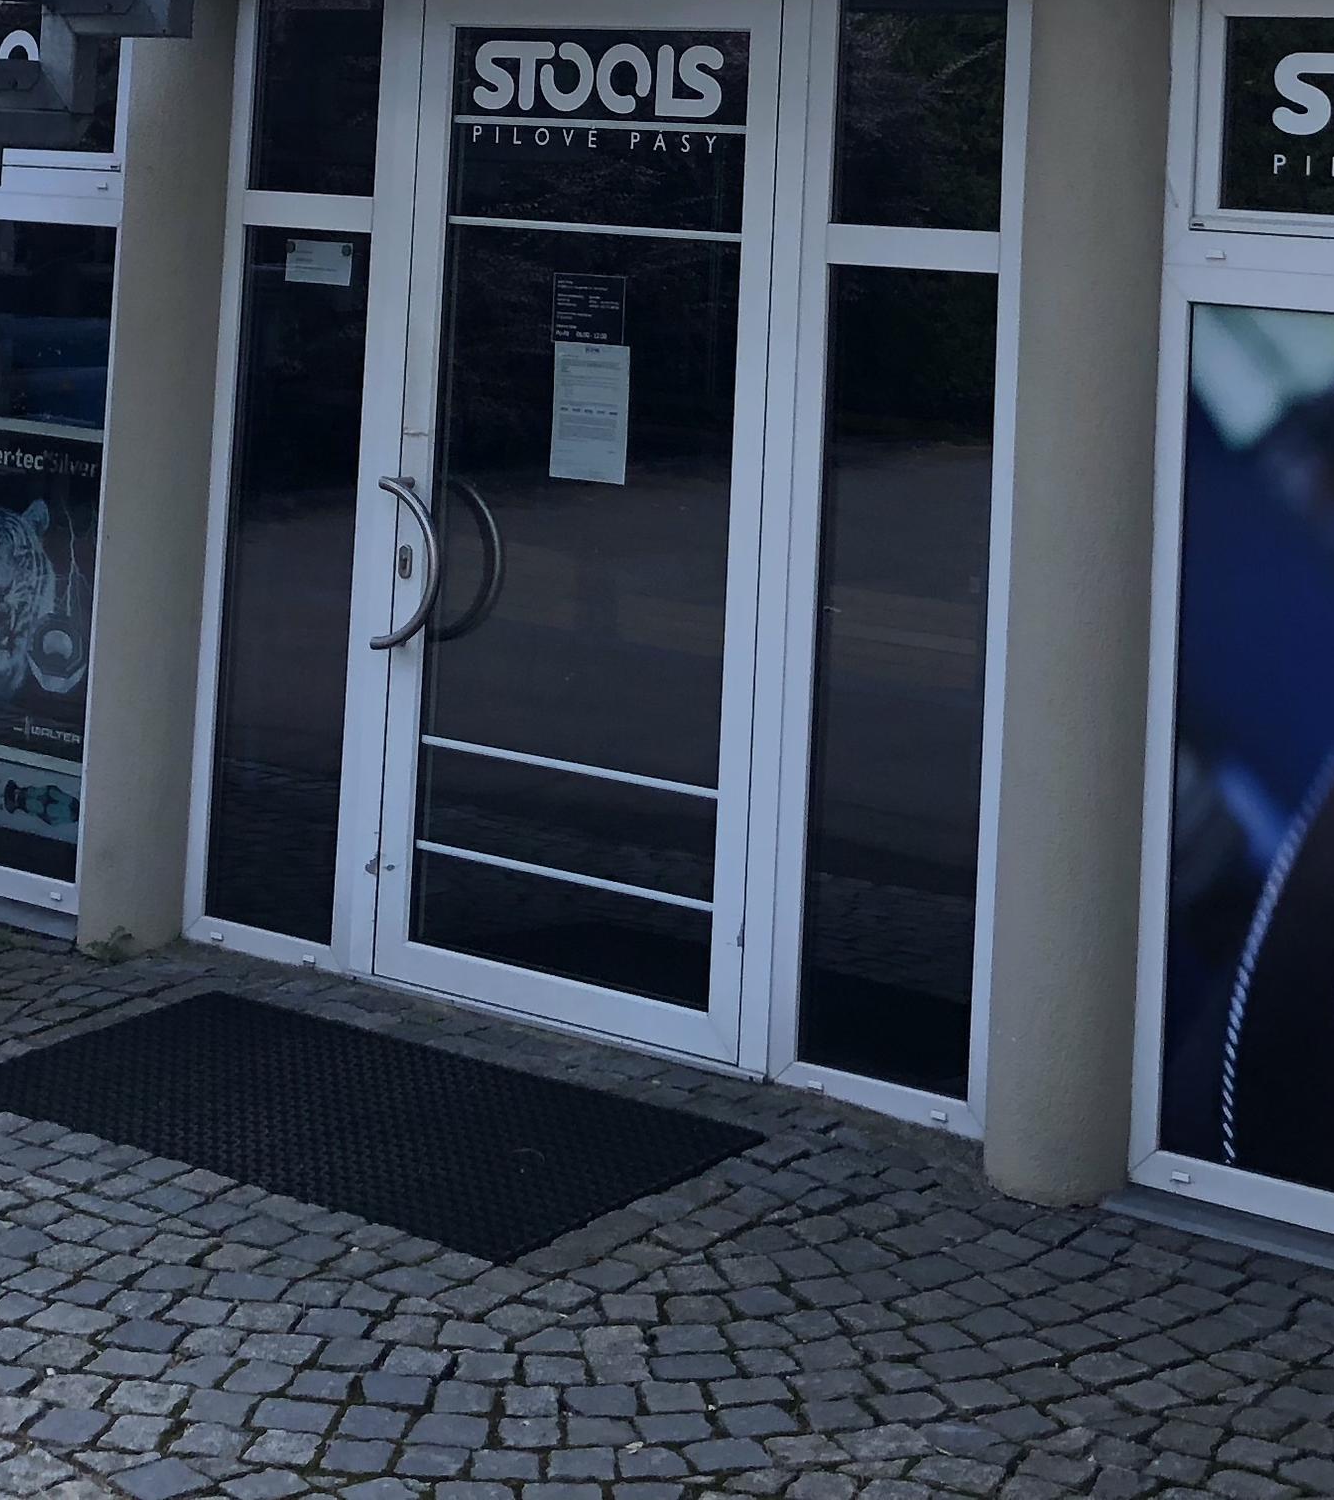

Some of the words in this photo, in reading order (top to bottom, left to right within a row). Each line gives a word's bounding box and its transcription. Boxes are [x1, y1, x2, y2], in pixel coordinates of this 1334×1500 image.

[473, 40, 724, 118] STOOLS
[473, 124, 598, 149] PILOVÉ
[629, 129, 717, 154] PÁSY
[31, 725, 81, 744] WALTER
